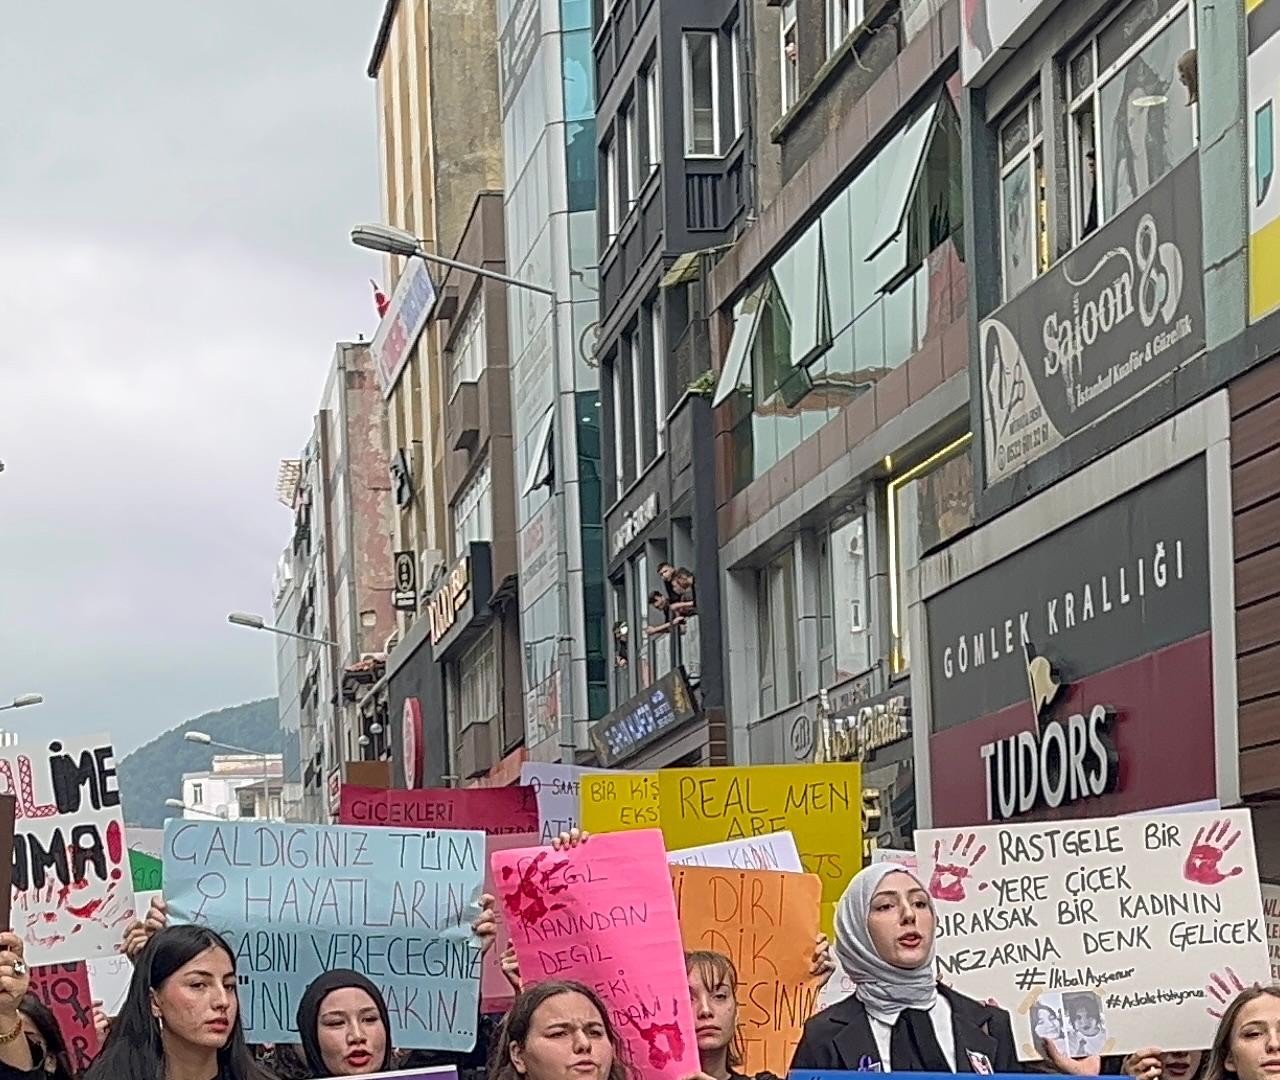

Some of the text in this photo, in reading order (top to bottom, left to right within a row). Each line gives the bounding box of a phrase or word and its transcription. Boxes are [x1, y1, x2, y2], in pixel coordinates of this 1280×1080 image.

[943, 538, 1184, 681] GÖMLEK KRALLIĞI
[979, 703, 1111, 822] TUDORS
[590, 777, 660, 802] BİR KİŞ
[678, 774, 850, 820] REAL MEN
[388, 830, 479, 872] TÜM
[727, 842, 780, 870] KADIN
[997, 821, 1182, 866] RASTGELE BİR
[244, 875, 466, 929] HAYATLARIN
[709, 872, 786, 927] DİRİ
[990, 864, 1133, 905] YERE ÇİÇEK
[519, 902, 649, 945] KANINDAN
[935, 890, 1223, 939] BIRAKSAK BİR KADININ
[220, 929, 484, 980] ABINI VERECEĞİNİZ
[700, 928, 780, 976] DİK
[935, 916, 1265, 976] MEZARINA DENK GELİCEK
[376, 982, 476, 1038] AKIN...
